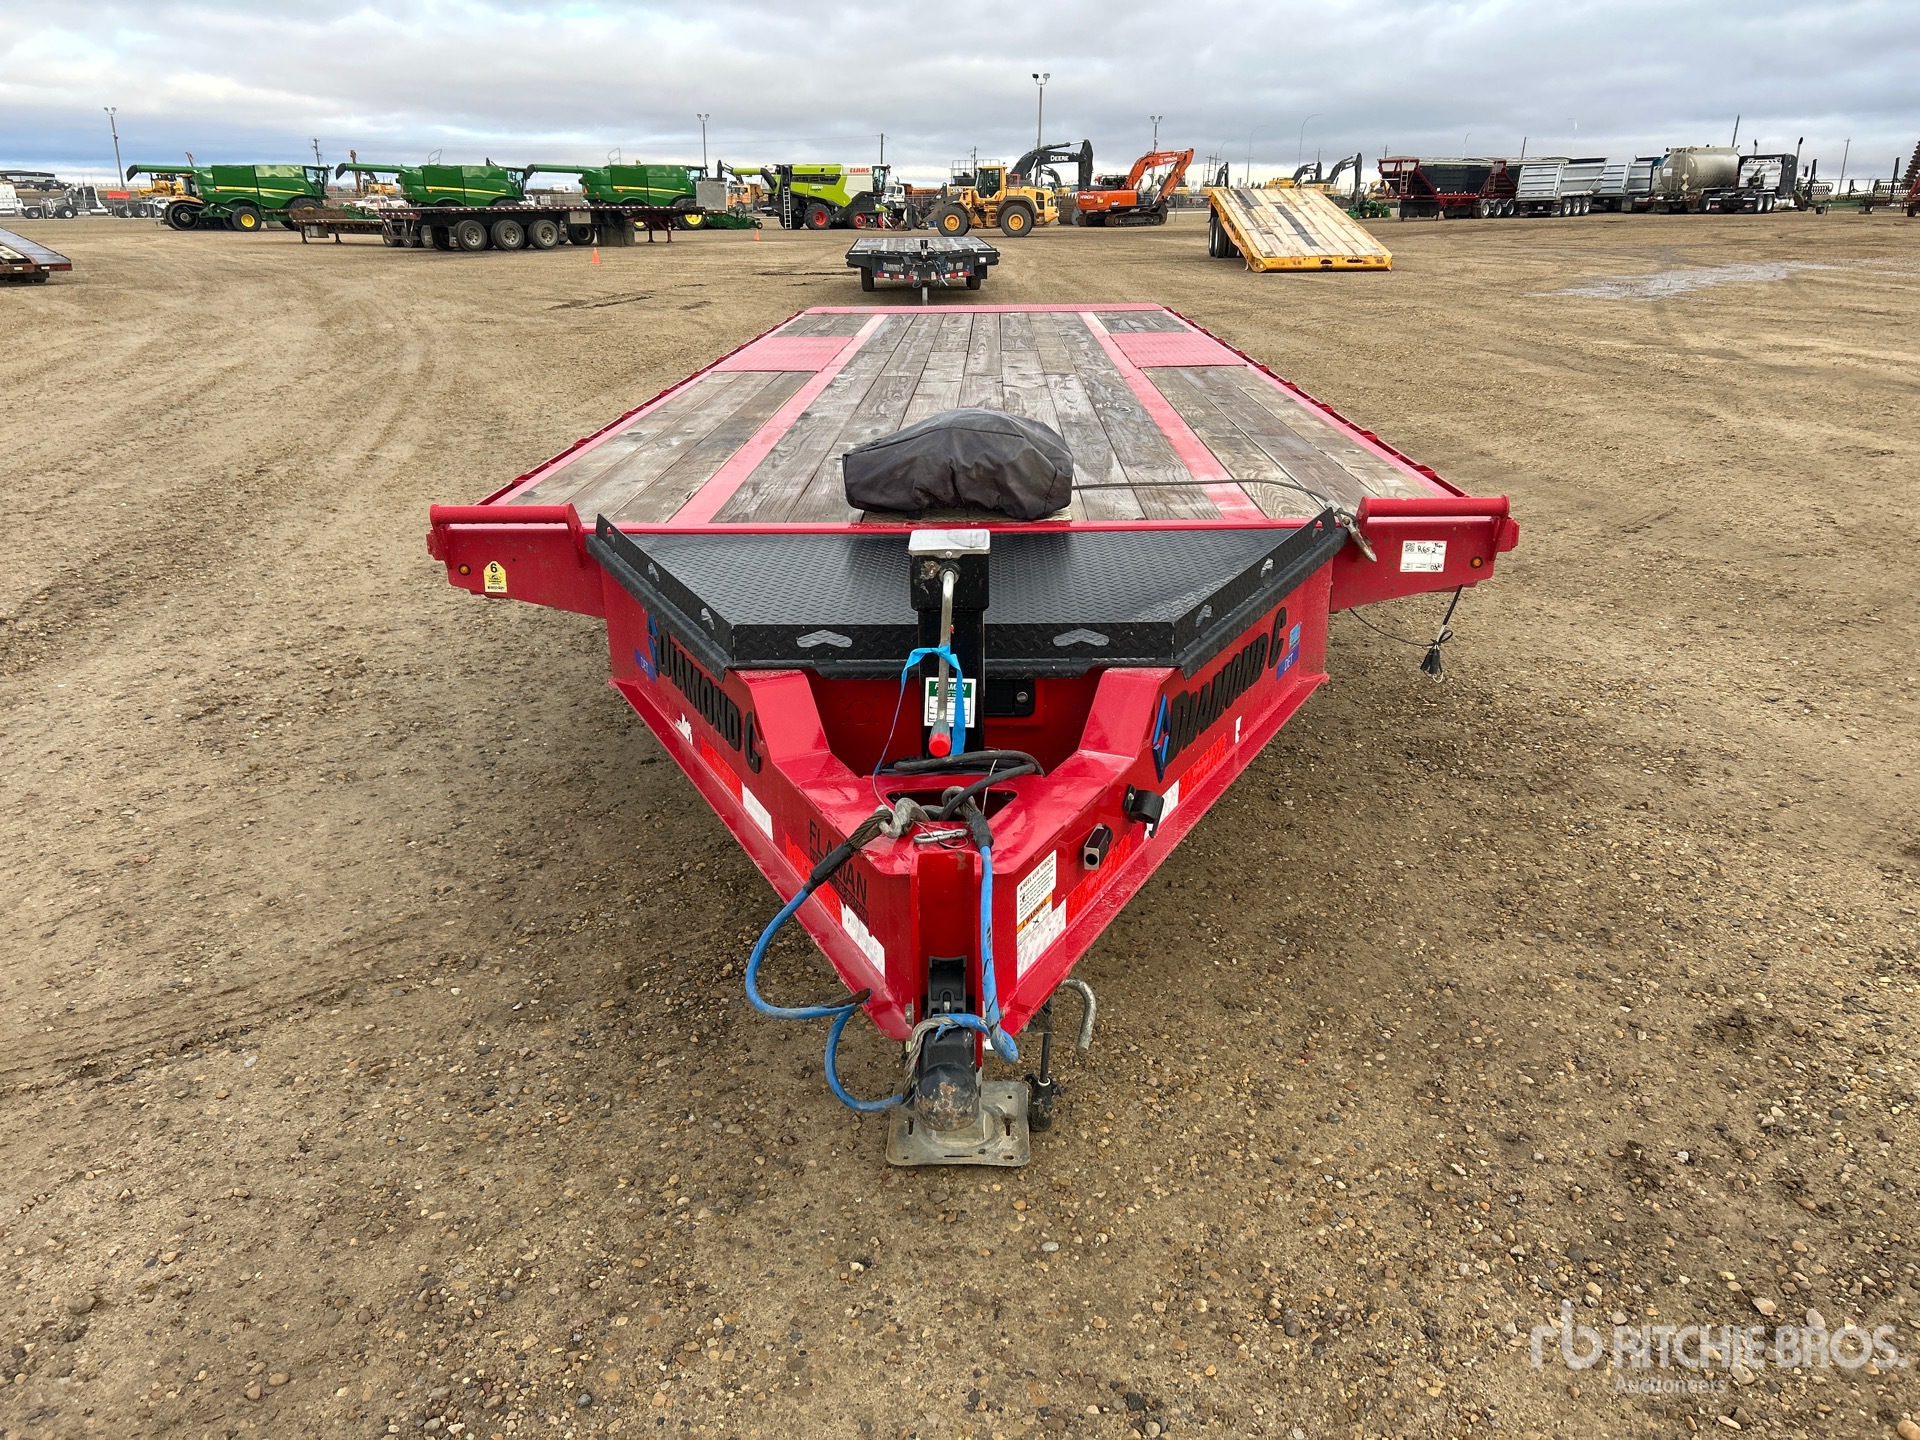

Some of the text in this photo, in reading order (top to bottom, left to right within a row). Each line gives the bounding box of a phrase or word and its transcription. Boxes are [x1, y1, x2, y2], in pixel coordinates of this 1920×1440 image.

[490, 563, 498, 573] 6
[657, 621, 762, 774] DIAMOND C
[1165, 606, 1287, 768] DIAMOND C
[809, 819, 867, 905] FLAAN
